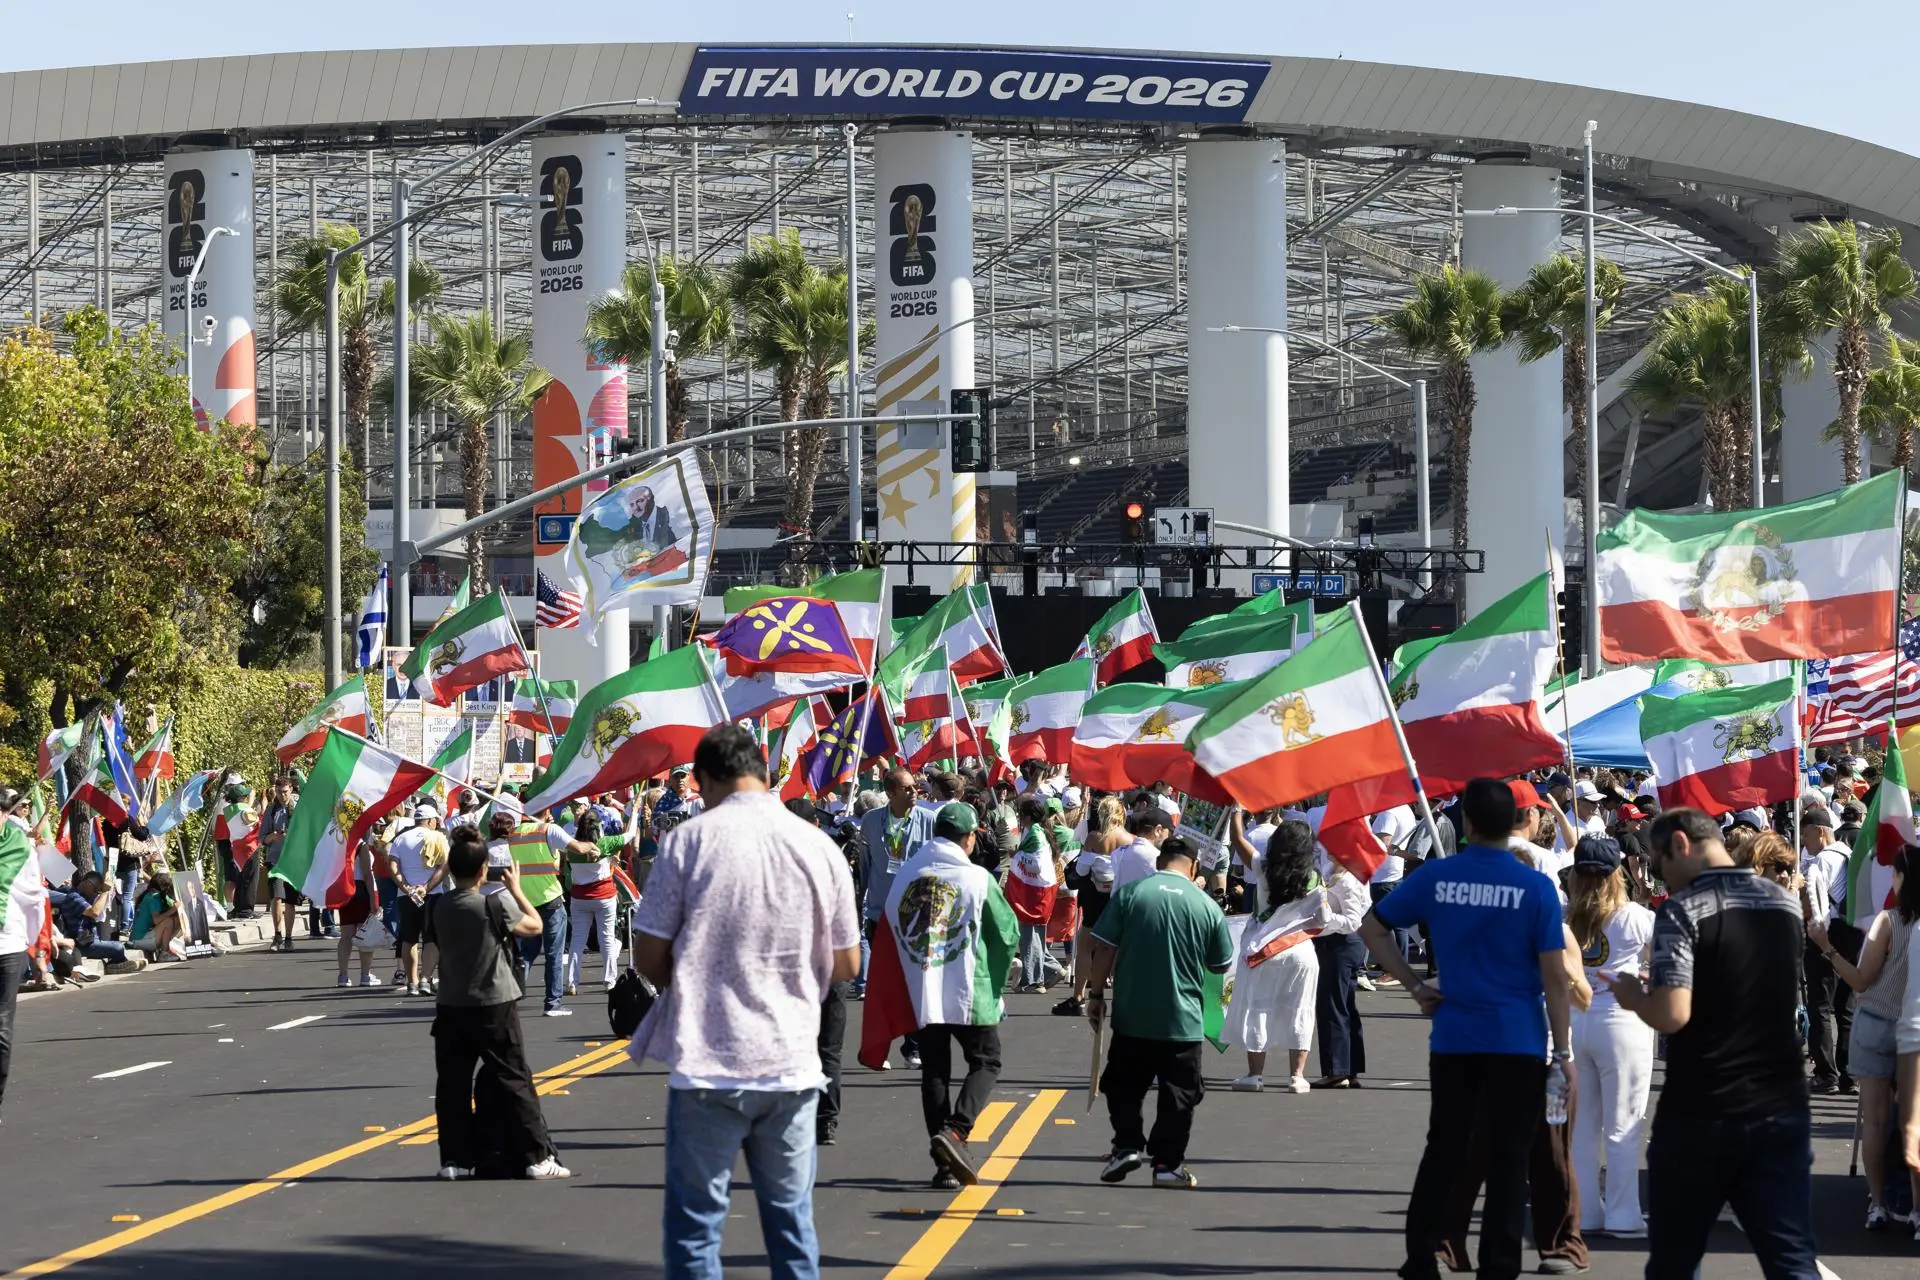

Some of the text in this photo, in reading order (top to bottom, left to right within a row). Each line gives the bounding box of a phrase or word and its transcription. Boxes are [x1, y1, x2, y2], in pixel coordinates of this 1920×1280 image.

[697, 67, 1249, 107] FIFA WORLD CUP 2026
[552, 238, 573, 252] FIFA
[178, 255, 196, 268] FIFA
[540, 263, 583, 278] WORLD CUP
[902, 265, 925, 278] FIFA
[170, 280, 207, 294] WOR CUP
[540, 275, 583, 294] 2026
[890, 289, 938, 302] WORLD CUP
[890, 301, 938, 319] 2026
[1158, 535, 1173, 543] ONLY
[1325, 579, 1340, 591] Dr
[465, 701, 480, 711] Best
[481, 701, 497, 712] King
[1434, 881, 1526, 910] SECURITY
